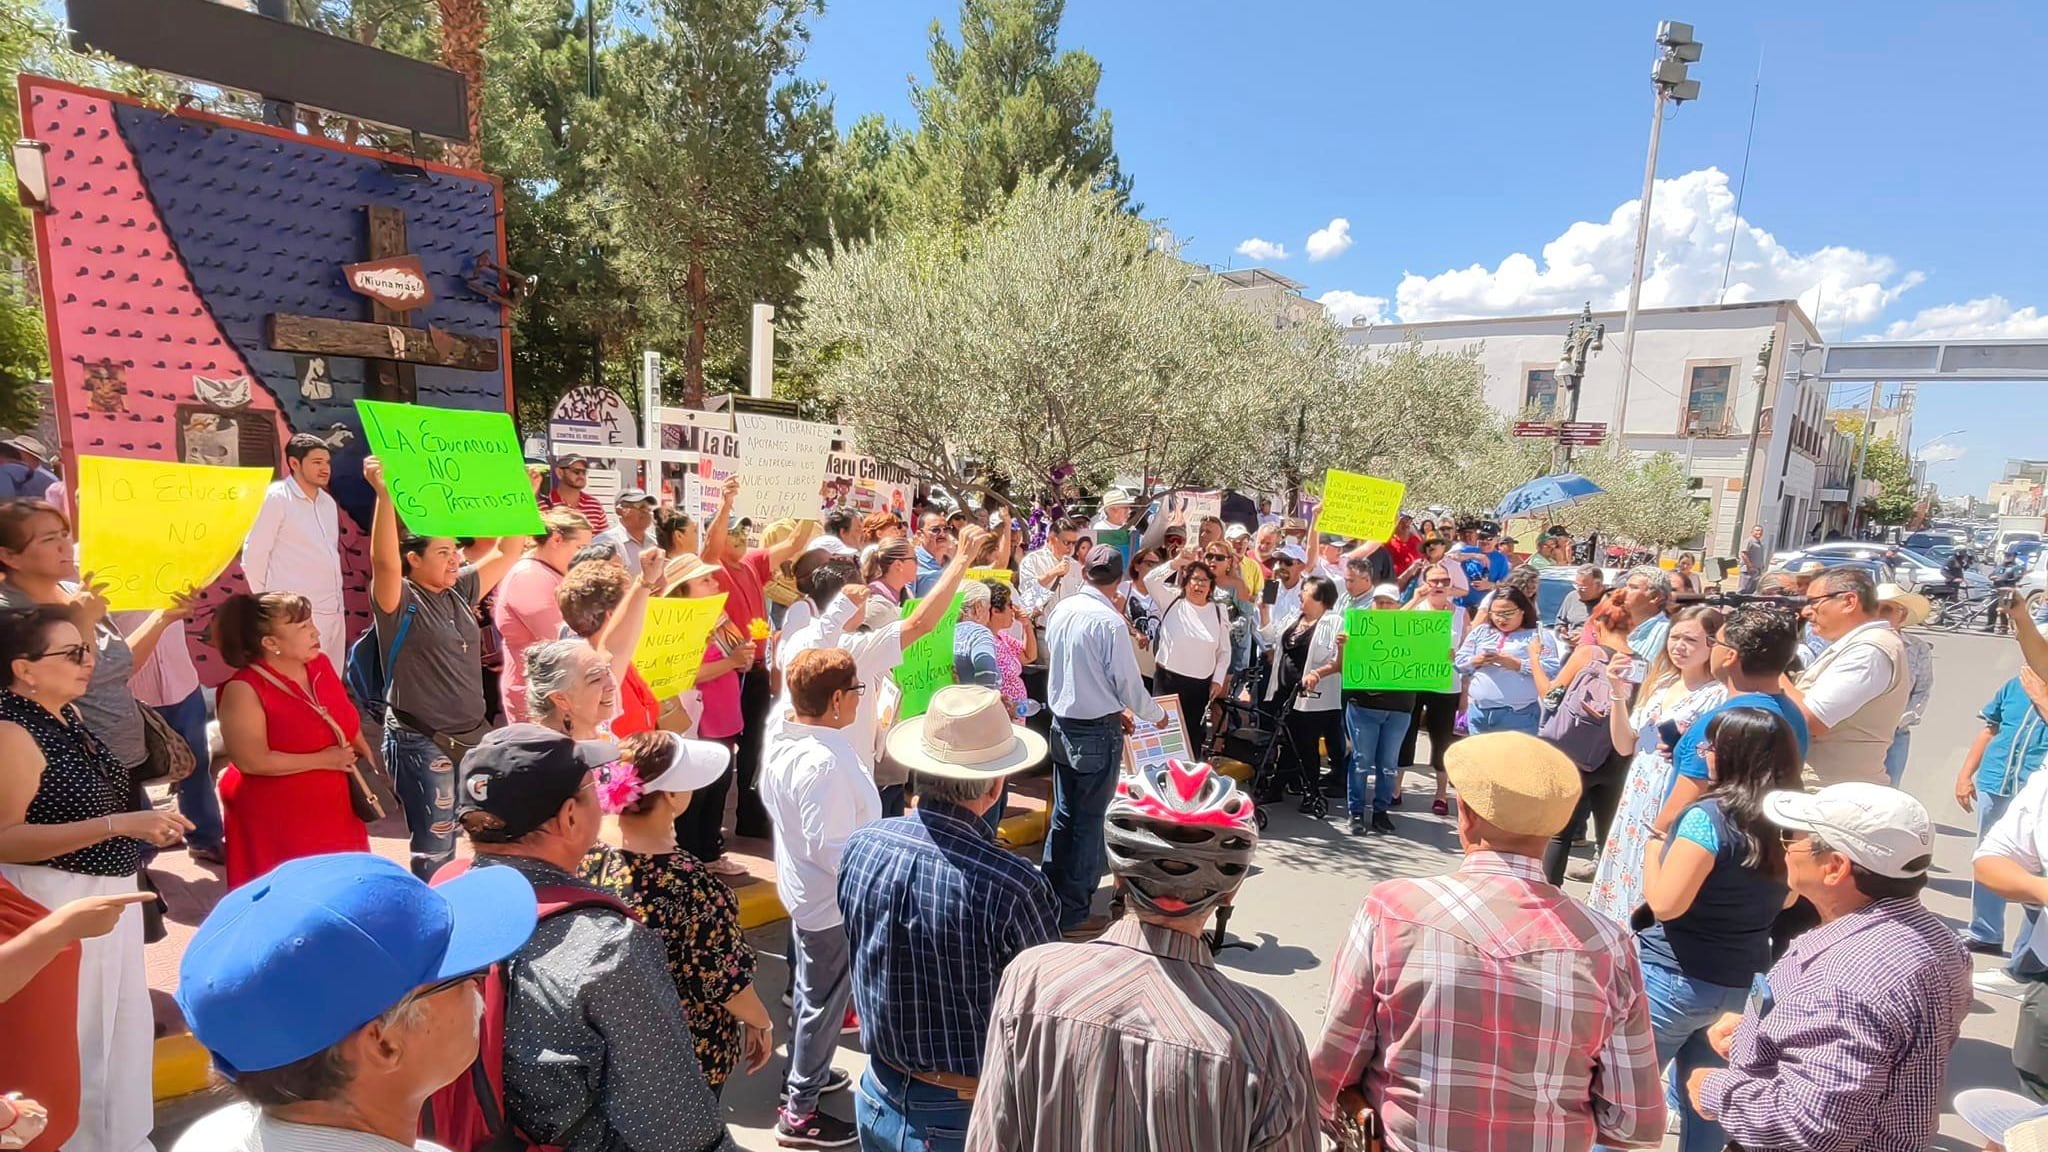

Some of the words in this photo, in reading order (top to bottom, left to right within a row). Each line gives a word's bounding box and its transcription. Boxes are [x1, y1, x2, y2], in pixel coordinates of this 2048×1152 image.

[367, 404, 416, 455] LA
[419, 419, 509, 454] EDUCACION
[743, 415, 767, 430] LOS
[775, 419, 829, 439] MIGRANTES
[427, 456, 460, 482] NO
[702, 431, 719, 455] La
[860, 458, 911, 485] Campos
[741, 475, 783, 487] NUEVOS
[393, 478, 427, 518] ES
[418, 482, 530, 514] PARTIDISTA
[756, 490, 768, 500] DE
[780, 491, 808, 502] TEXTO
[169, 520, 206, 544] NO
[653, 608, 694, 626] VIVA
[1350, 616, 1380, 637] LOS
[1394, 615, 1449, 637] LIBROS
[646, 632, 686, 648] NUEVA
[1350, 664, 1380, 684] UN
[1382, 661, 1451, 681] DERECHO
